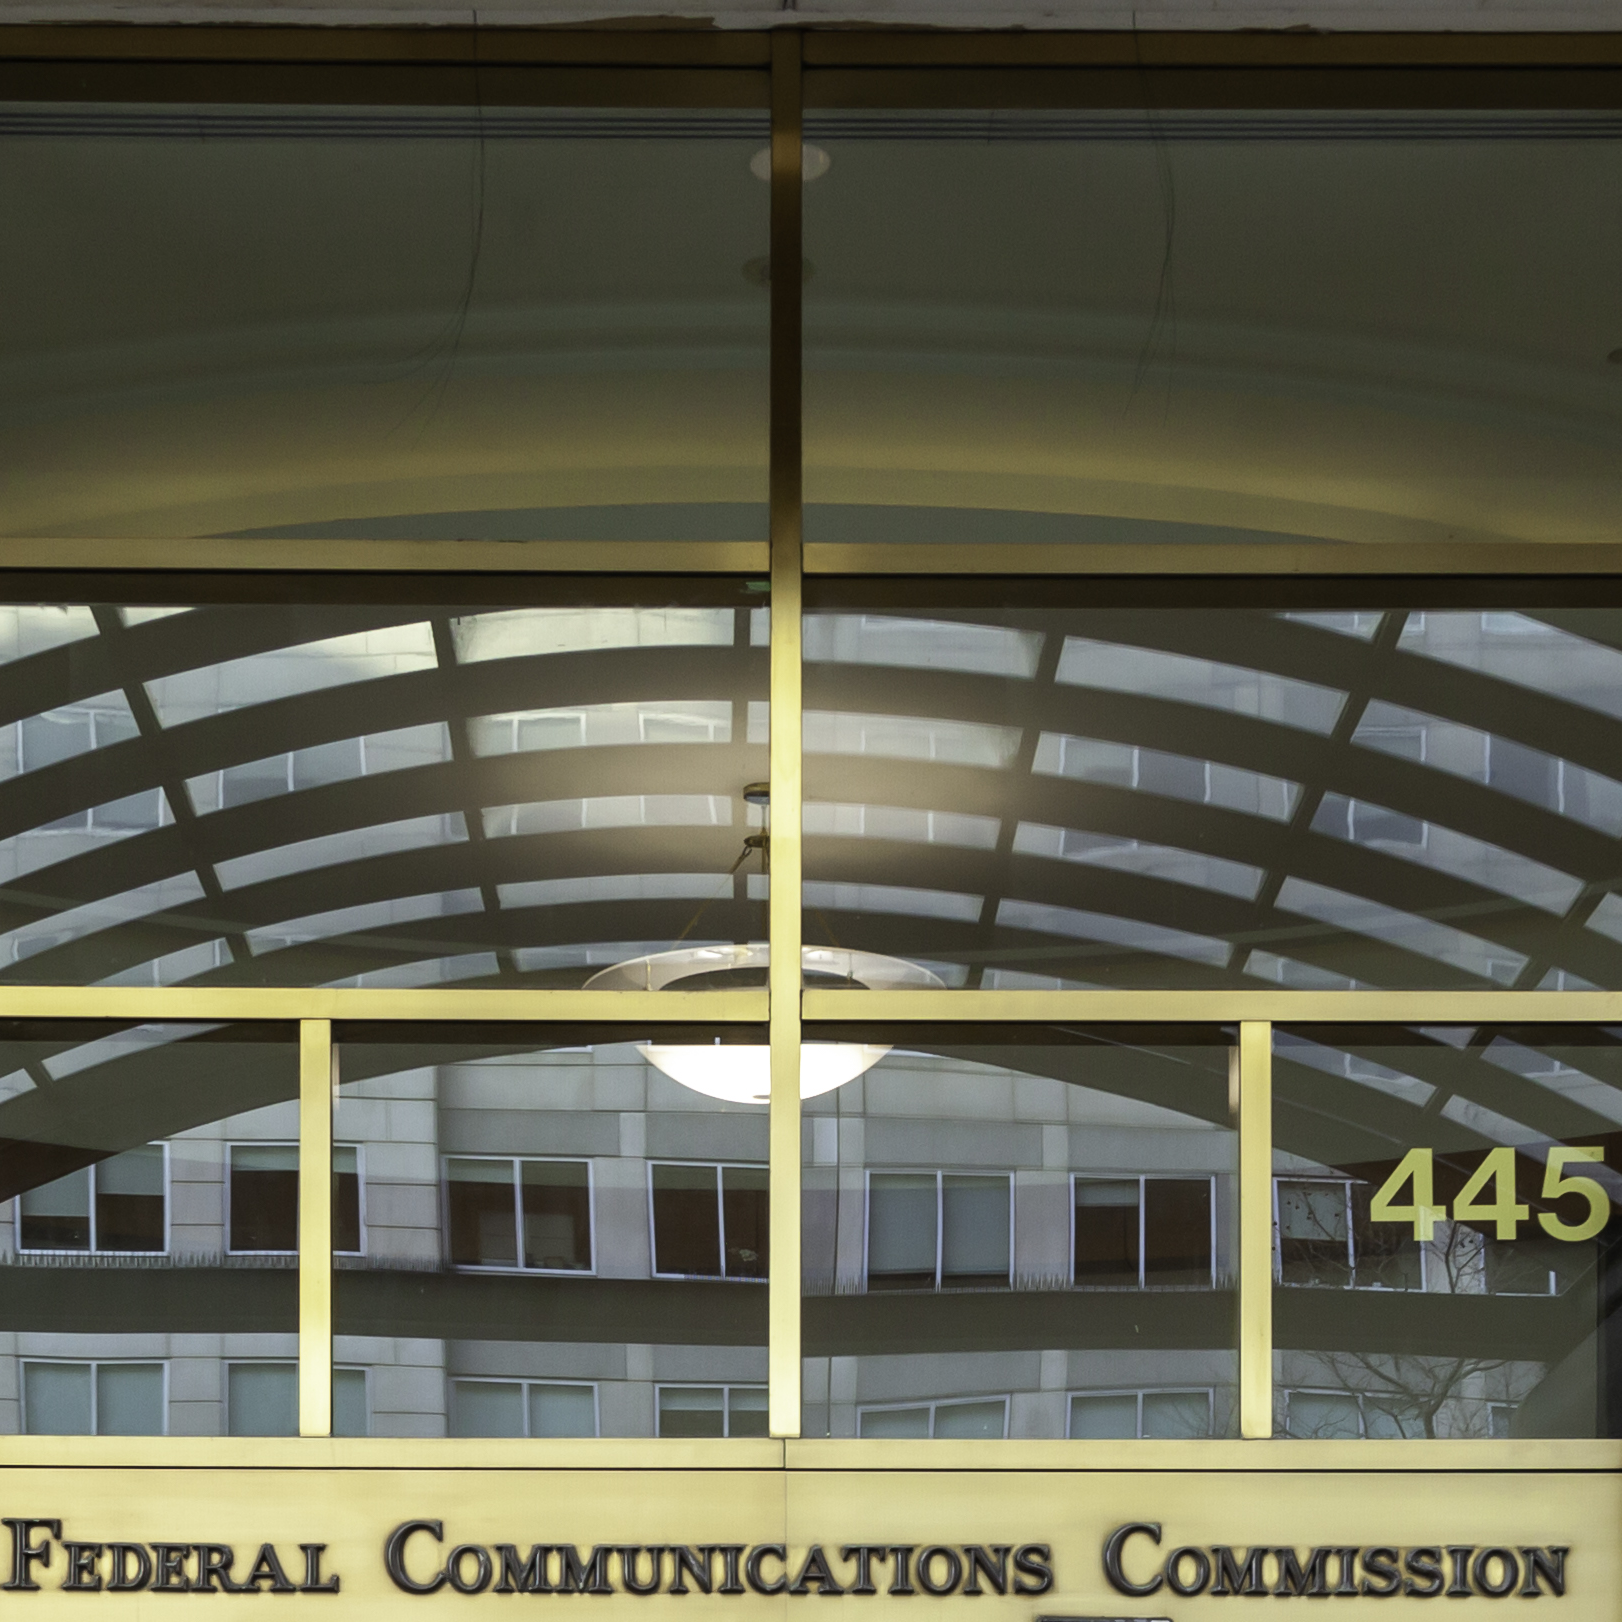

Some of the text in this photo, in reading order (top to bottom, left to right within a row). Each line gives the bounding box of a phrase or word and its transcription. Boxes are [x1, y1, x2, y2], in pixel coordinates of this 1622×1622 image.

[1370, 1146, 1611, 1242] 445
[0, 1517, 1570, 1598] FEDERAL COMMUNICATIONS COMMISSION
